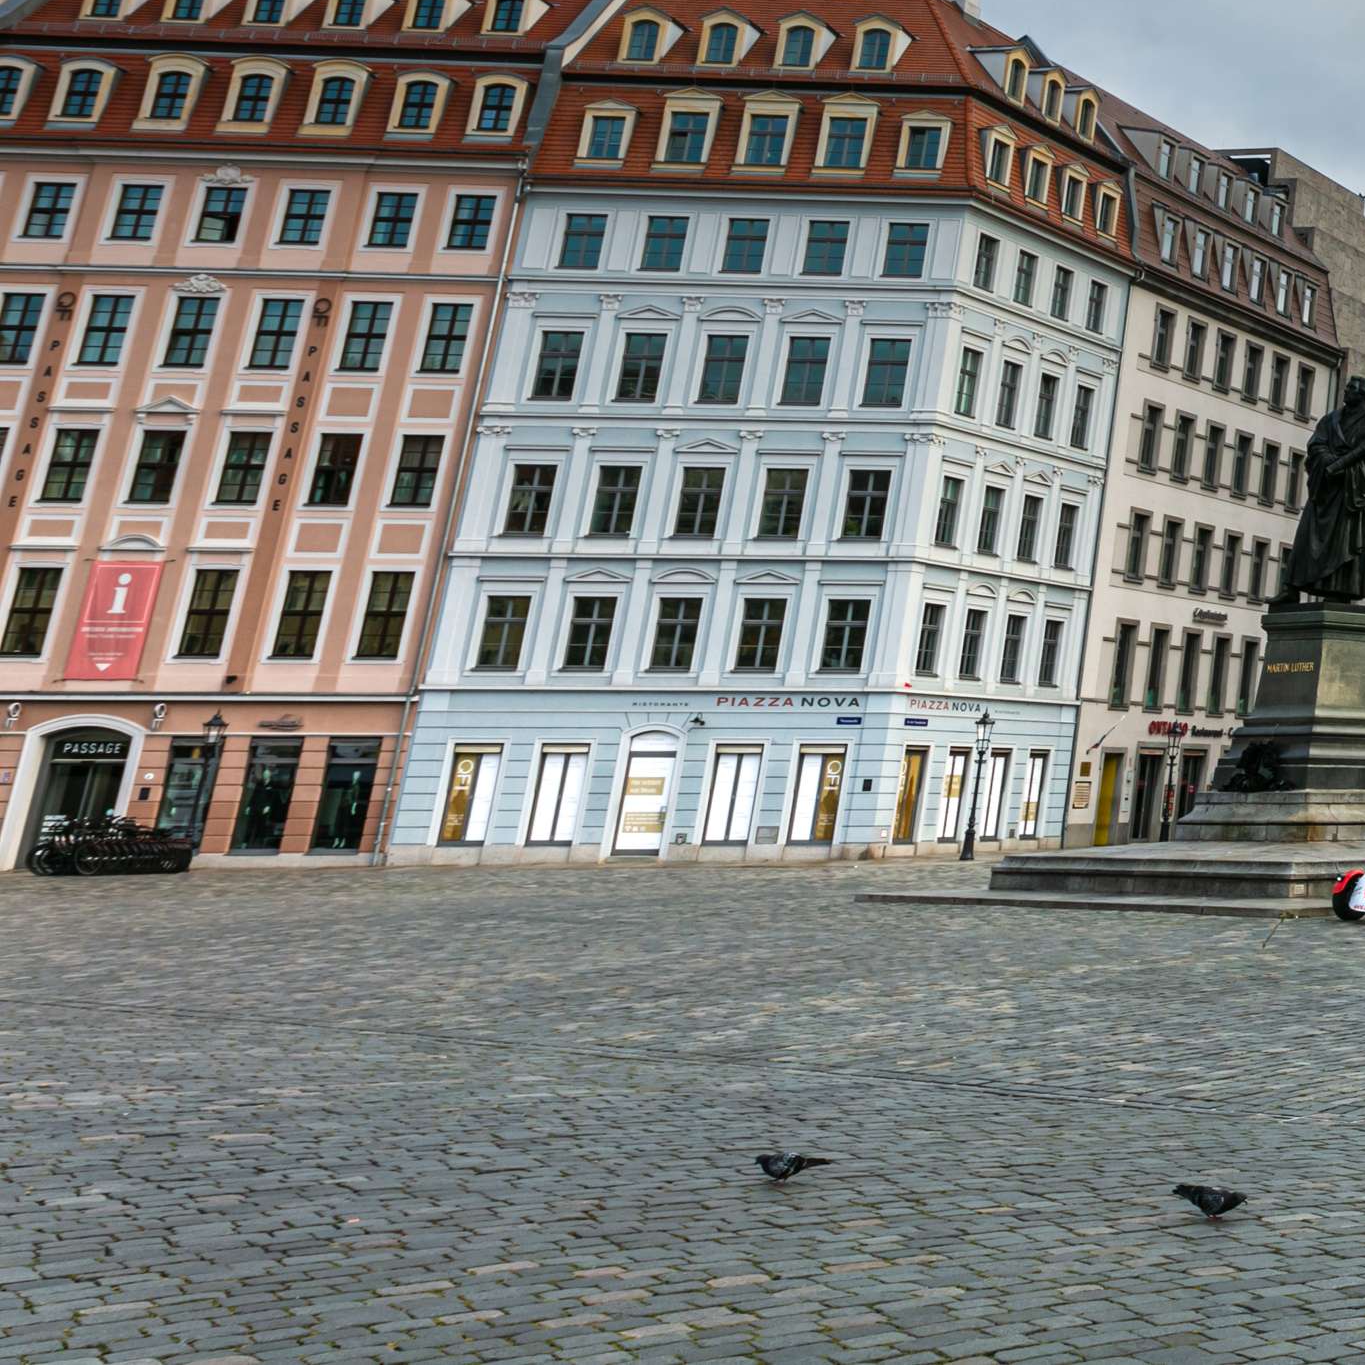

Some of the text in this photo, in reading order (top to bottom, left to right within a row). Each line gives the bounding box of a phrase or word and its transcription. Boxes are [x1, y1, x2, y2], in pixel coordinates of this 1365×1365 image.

[8, 340, 61, 508] PASSAGE
[272, 346, 317, 511] PASSAGE
[1267, 662, 1314, 674] MARTIN LUTHER
[716, 697, 860, 707] PIAZZA NOVA
[910, 698, 950, 711] PIAZZA
[952, 702, 981, 713] NOVA
[63, 742, 122, 754] PASSAGE
